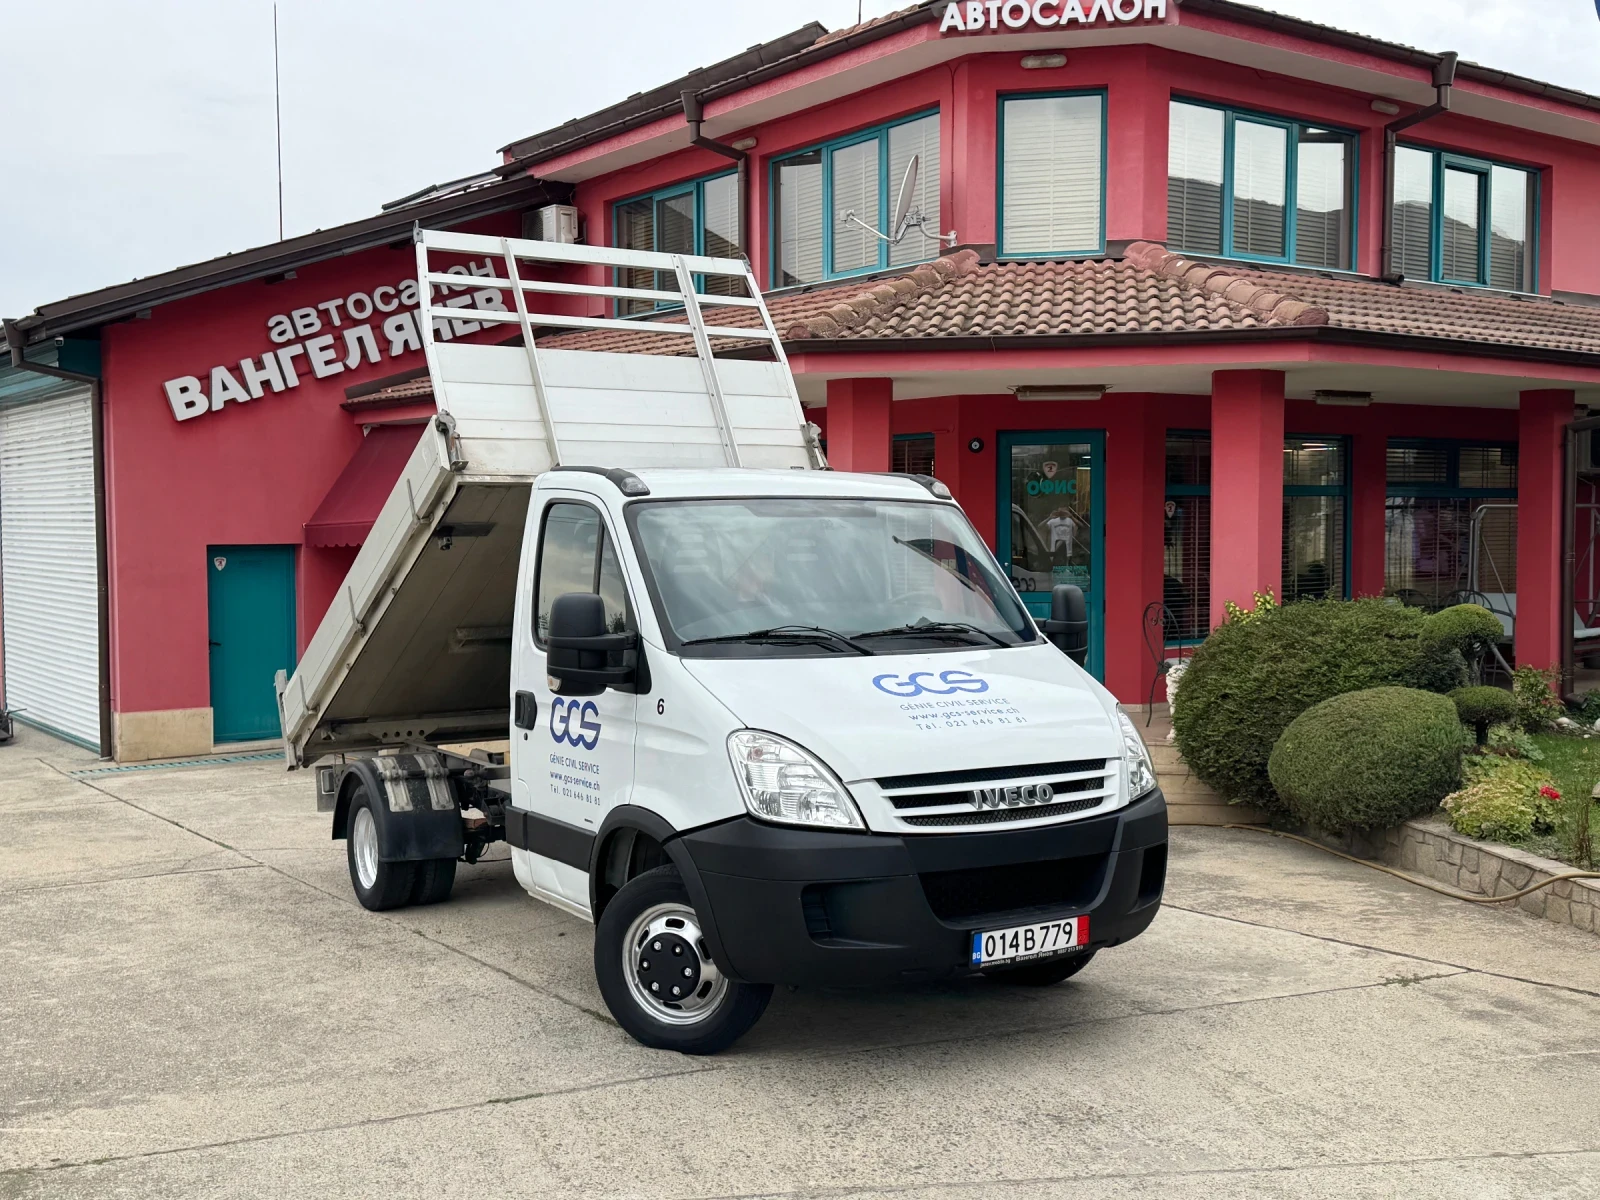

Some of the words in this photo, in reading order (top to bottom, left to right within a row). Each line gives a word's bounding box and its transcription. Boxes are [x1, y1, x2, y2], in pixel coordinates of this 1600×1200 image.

[939, 0, 1167, 33] АВТОСАЛОН
[163, 323, 382, 422] ВАНГЕЛ
[1027, 480, 1076, 496] ОФИС
[872, 670, 989, 697] GCS
[657, 698, 665, 715] 6
[899, 701, 935, 711] GÉNIE
[936, 700, 965, 708] CIVIL
[965, 698, 1011, 706] SERVICE
[908, 706, 1020, 719] www.gcs-service.ch
[549, 696, 602, 750] GCS
[945, 719, 968, 728] 021
[972, 718, 994, 726] 646
[998, 716, 1012, 724] 81
[1015, 715, 1027, 723] 81
[549, 751, 564, 766] GÉNIE
[565, 757, 577, 769] CIVIL
[578, 760, 600, 775] SERVICE
[550, 770, 601, 791] www.gcs-service.ch
[562, 787, 572, 798] 021
[573, 790, 584, 801] 646
[586, 793, 592, 804] 81
[969, 783, 1054, 811] IVECO
[985, 921, 1073, 958] 014B779
[972, 952, 981, 961] BG
